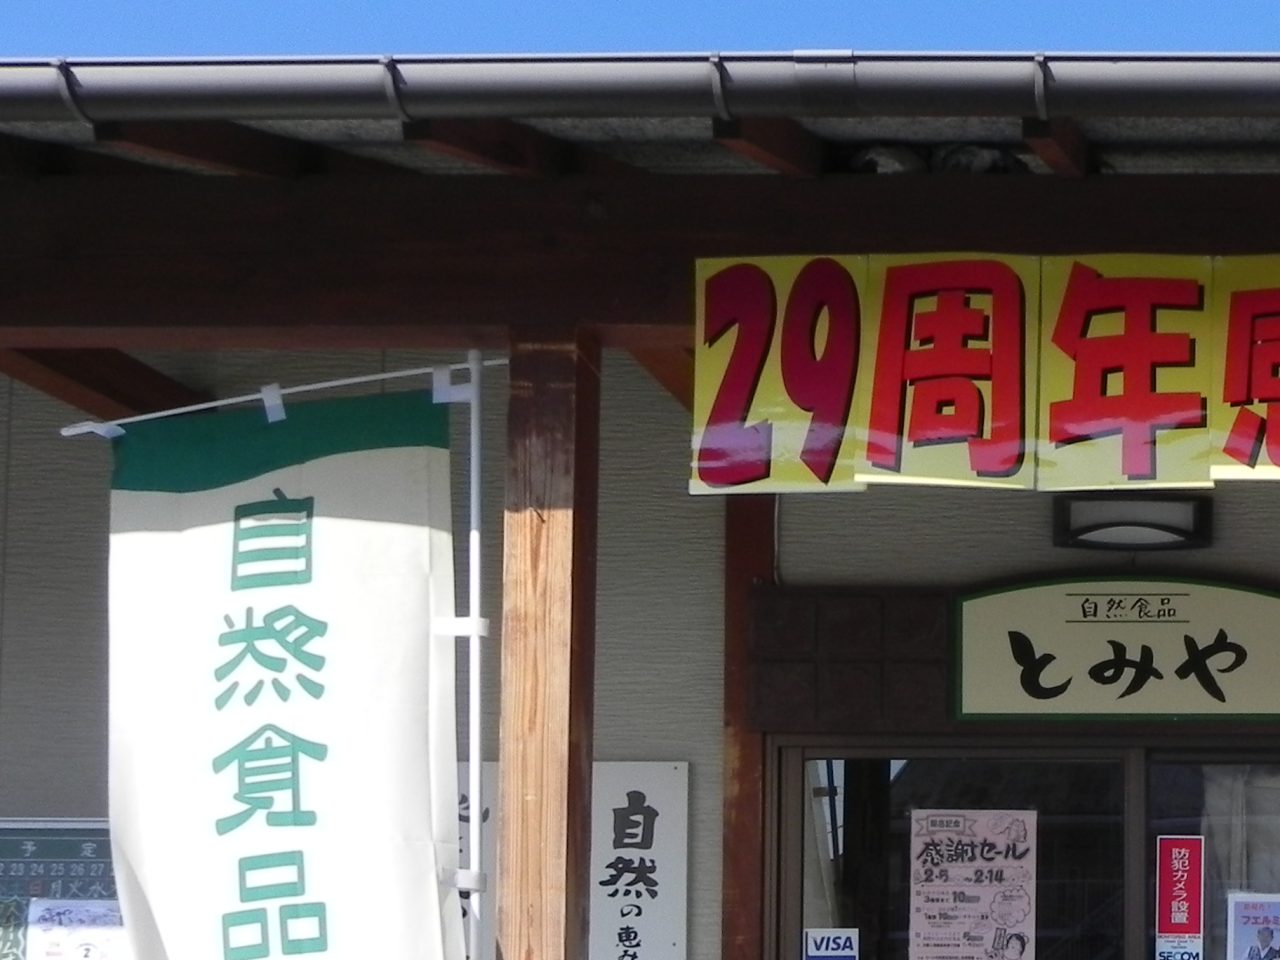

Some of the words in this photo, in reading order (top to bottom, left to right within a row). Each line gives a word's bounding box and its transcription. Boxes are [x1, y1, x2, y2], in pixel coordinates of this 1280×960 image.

[1081, 597, 1177, 619] 自然食品
[1008, 629, 1248, 704] とみや
[916, 837, 1030, 868] 感謝セール
[30, 863, 45, 876] 24
[50, 863, 65, 876] 25
[69, 863, 85, 876] 26
[89, 863, 105, 876] 27
[1170, 847, 1191, 925] 防犯カメラ設置
[811, 936, 854, 951] VISA
